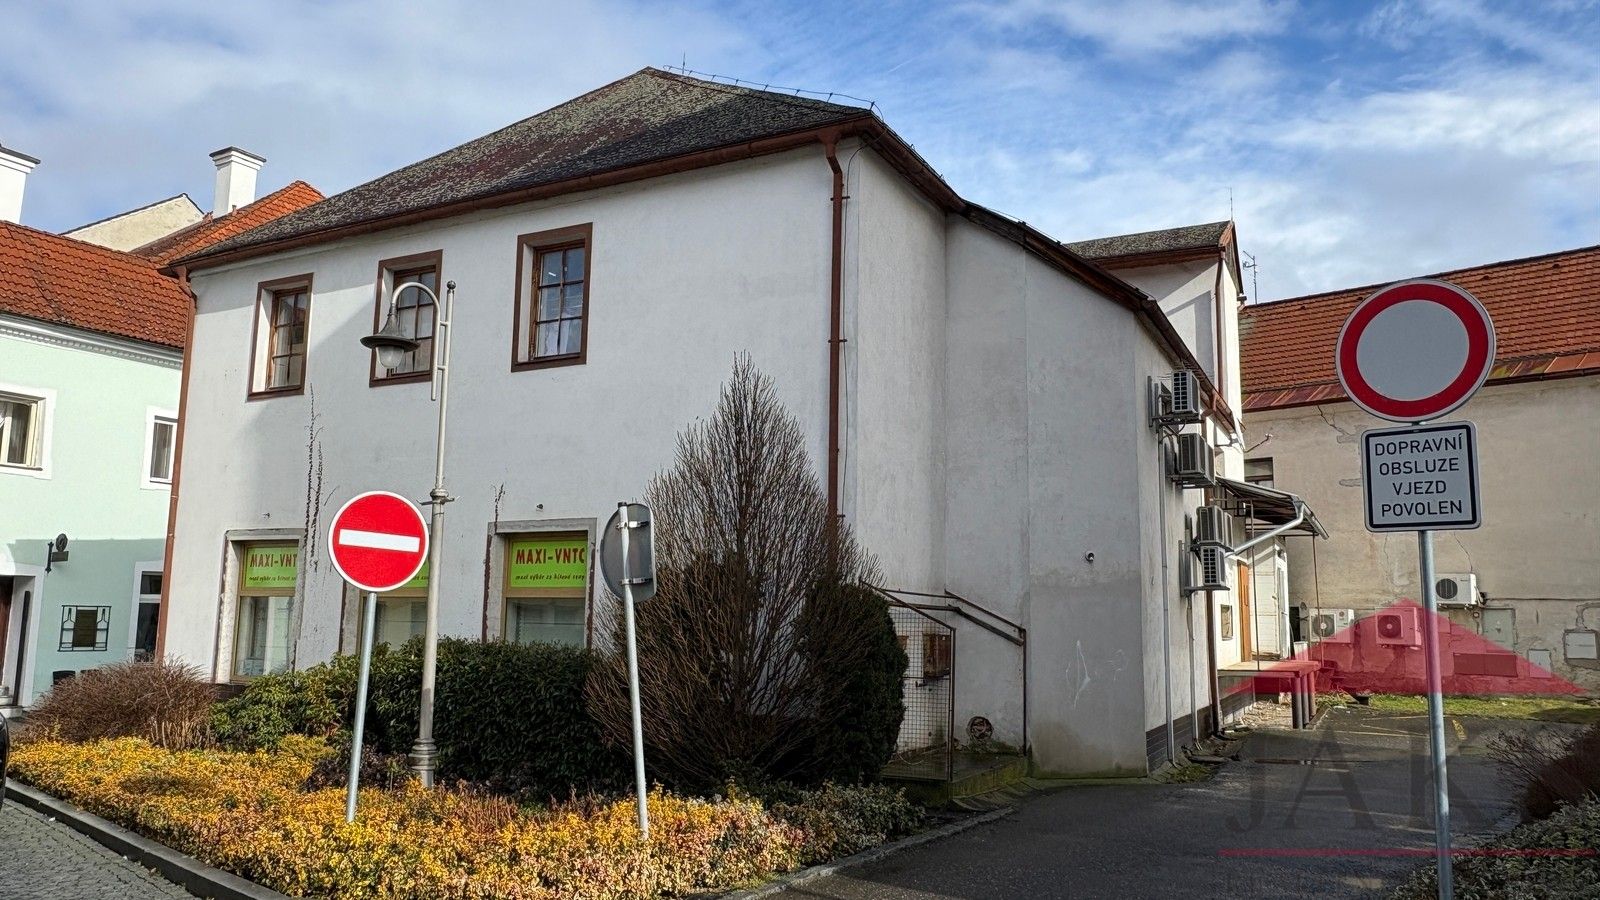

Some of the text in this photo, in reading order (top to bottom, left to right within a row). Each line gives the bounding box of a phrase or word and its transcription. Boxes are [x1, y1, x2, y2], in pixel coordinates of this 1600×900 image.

[1375, 433, 1463, 456] DOPRAVNÍ
[1379, 457, 1460, 476] OBSLUZE
[1392, 480, 1447, 496] VJEZD
[1381, 500, 1462, 517] POVOLEN
